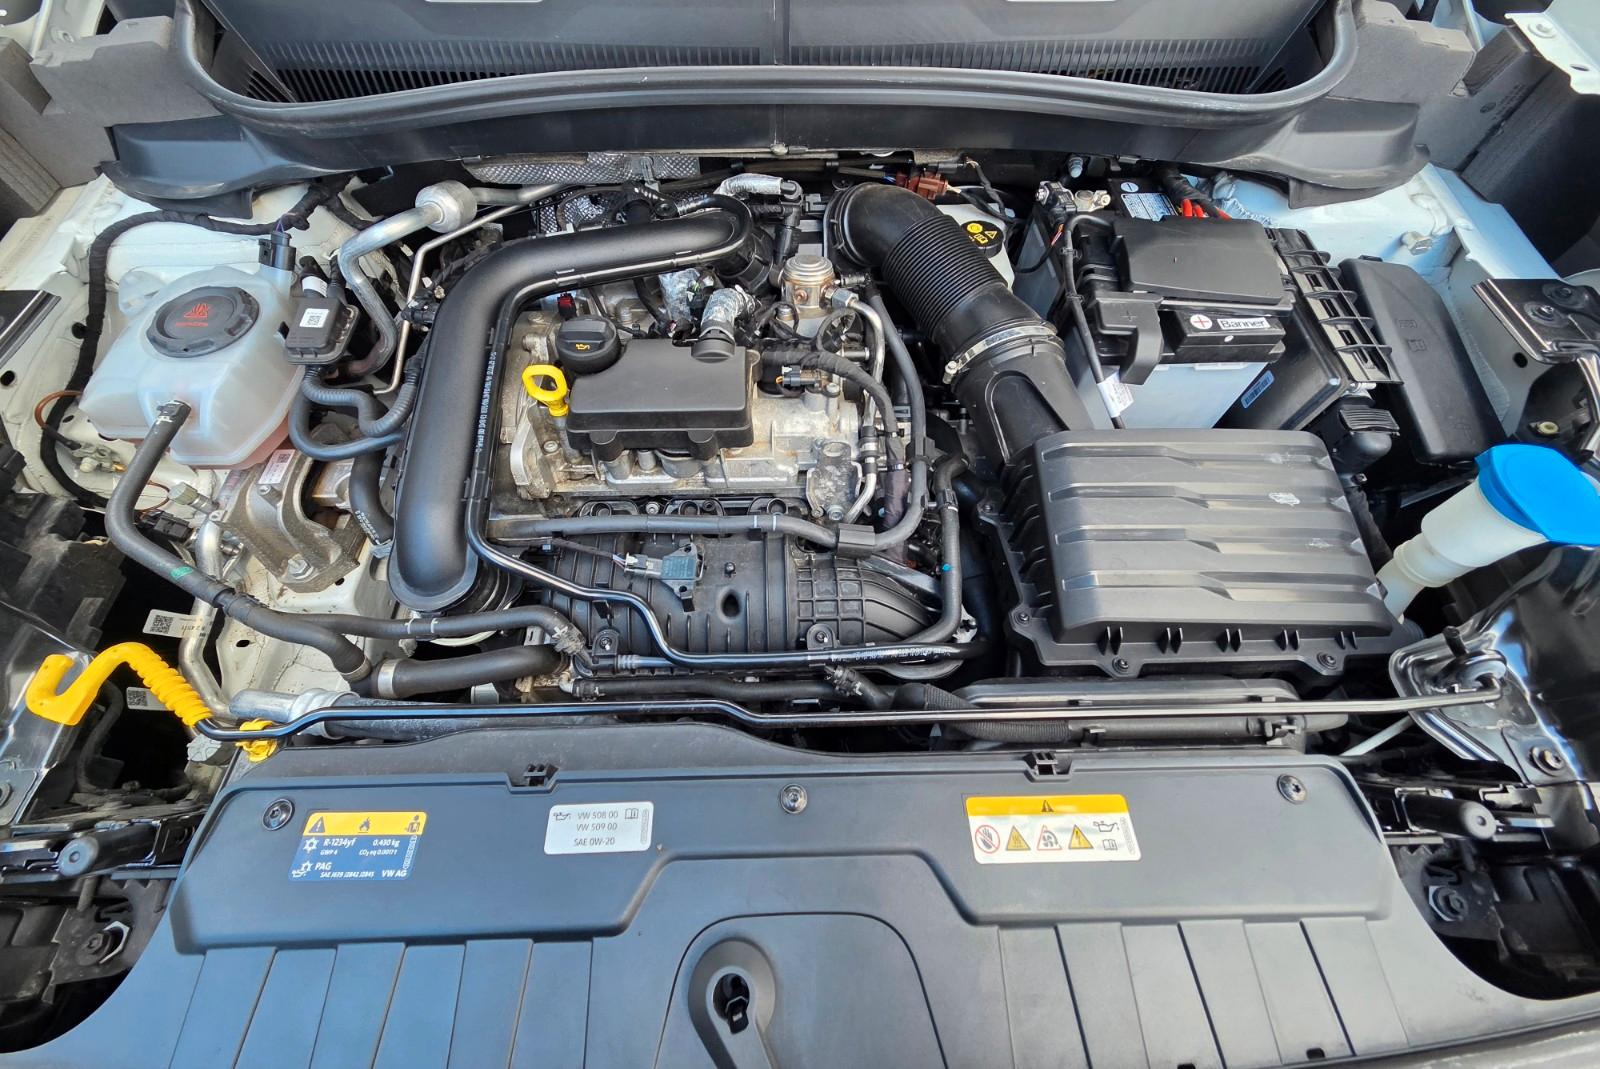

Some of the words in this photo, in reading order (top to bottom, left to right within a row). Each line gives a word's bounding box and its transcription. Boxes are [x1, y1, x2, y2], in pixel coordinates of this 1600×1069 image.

[1220, 320, 1265, 328] Banner
[577, 812, 590, 820] VW
[592, 811, 606, 820] 508
[608, 811, 619, 819] 00
[576, 823, 589, 831] VW
[591, 823, 606, 831] 509
[607, 822, 618, 830] 00
[324, 838, 356, 848] R-1234yf
[391, 839, 400, 847] kg
[589, 837, 616, 846] 0W-20
[315, 862, 332, 870] PAG
